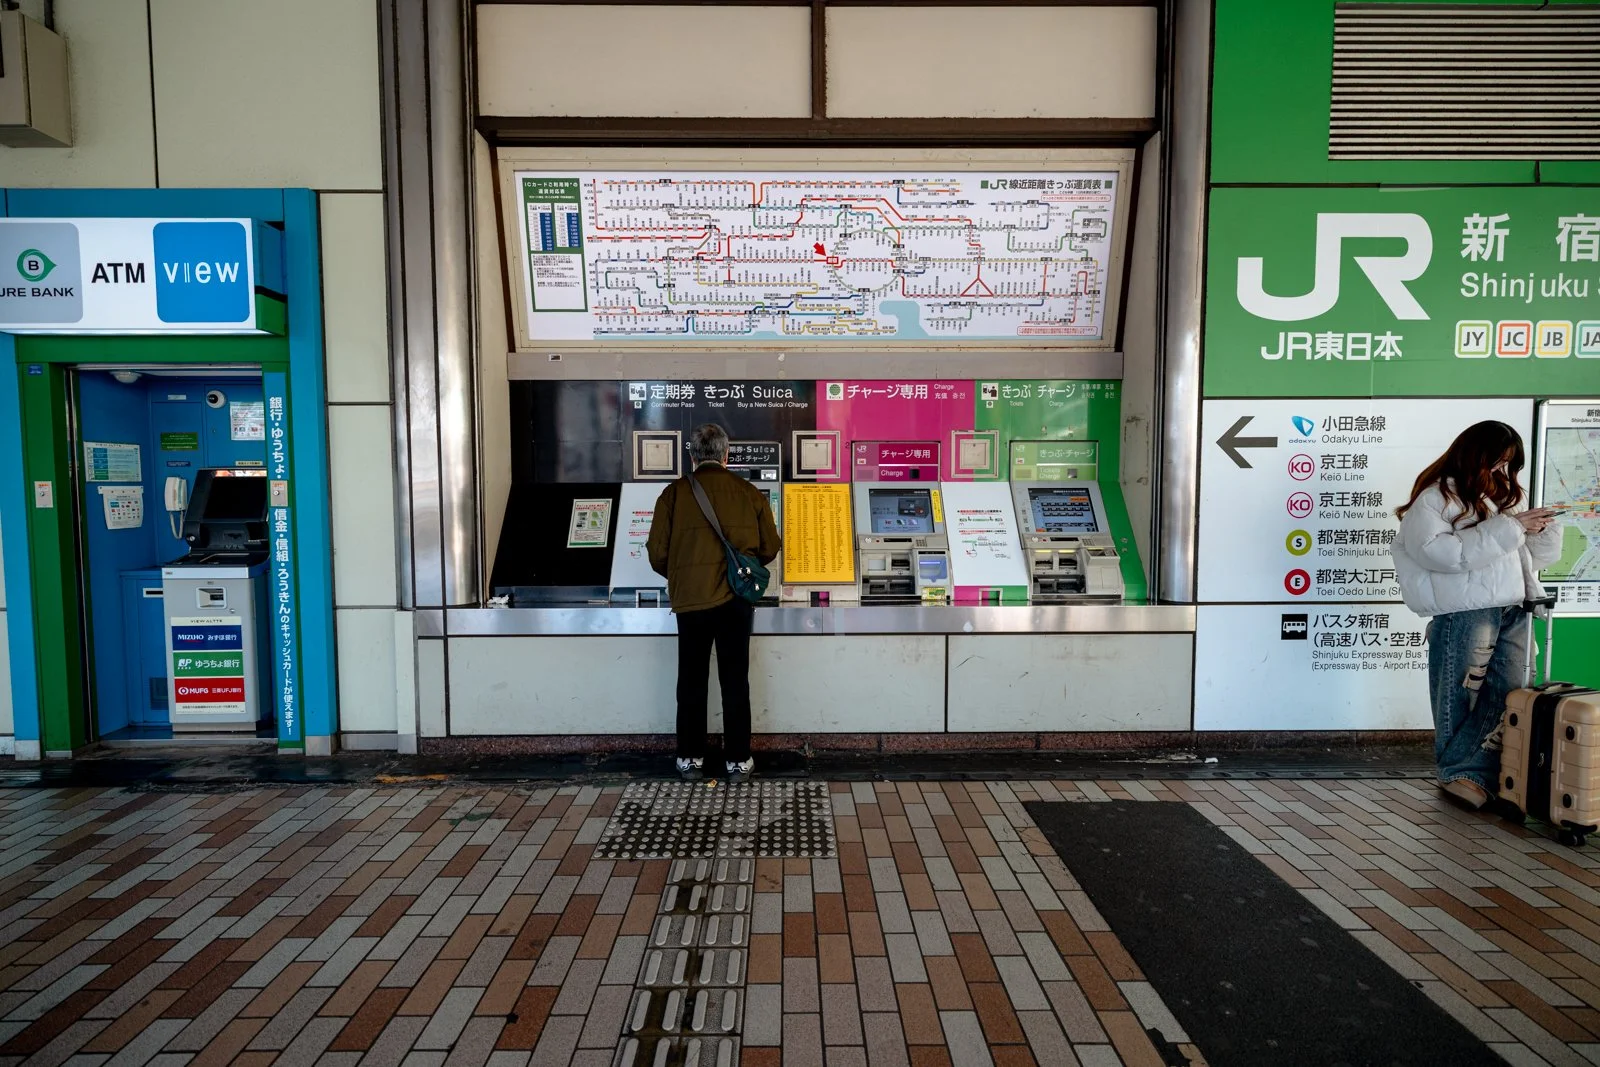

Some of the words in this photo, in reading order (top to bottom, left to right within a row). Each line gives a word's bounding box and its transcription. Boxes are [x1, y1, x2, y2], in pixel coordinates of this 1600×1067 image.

[91, 262, 146, 284] ATM
[1237, 212, 1433, 322] JR
[32, 288, 74, 297] BANK
[1460, 272, 1589, 304] Shinjuku
[1261, 331, 1404, 361] JR東日本
[1463, 332, 1485, 346] JY
[1504, 332, 1524, 346] JC
[1544, 332, 1564, 346] JB
[1582, 332, 1600, 346] JA
[650, 384, 696, 400] 定期券
[704, 384, 745, 400] きっぷ
[752, 386, 793, 398] Suica
[847, 384, 928, 400] チャージ専用
[1002, 384, 1032, 398] きっぷ
[1038, 384, 1076, 398] チャージ
[1322, 416, 1386, 432] 小田急線
[1322, 435, 1360, 445] Odakyu
[1362, 435, 1383, 443] Line
[881, 450, 930, 458] チャージ専用
[1291, 462, 1312, 473] KO
[1320, 454, 1368, 469] 京王線
[1290, 500, 1310, 511] KO
[1319, 492, 1383, 507] 京王新線
[1295, 538, 1302, 548] S
[1317, 548, 1335, 556] Toei
[1337, 548, 1374, 558] Shinjuku
[1295, 578, 1300, 586] E
[1316, 587, 1335, 596] Toei
[1338, 587, 1364, 596] Oedo
[1366, 587, 1386, 596] Line
[1313, 614, 1390, 628] バスタ新宿
[1312, 651, 1349, 660] Shinjuku
[1351, 651, 1403, 660] Expressway
[1405, 650, 1424, 658] Bus
[195, 659, 240, 669] ゆうちょ銀行
[1312, 662, 1361, 672] (Expressway
[1383, 661, 1410, 671] Airport
